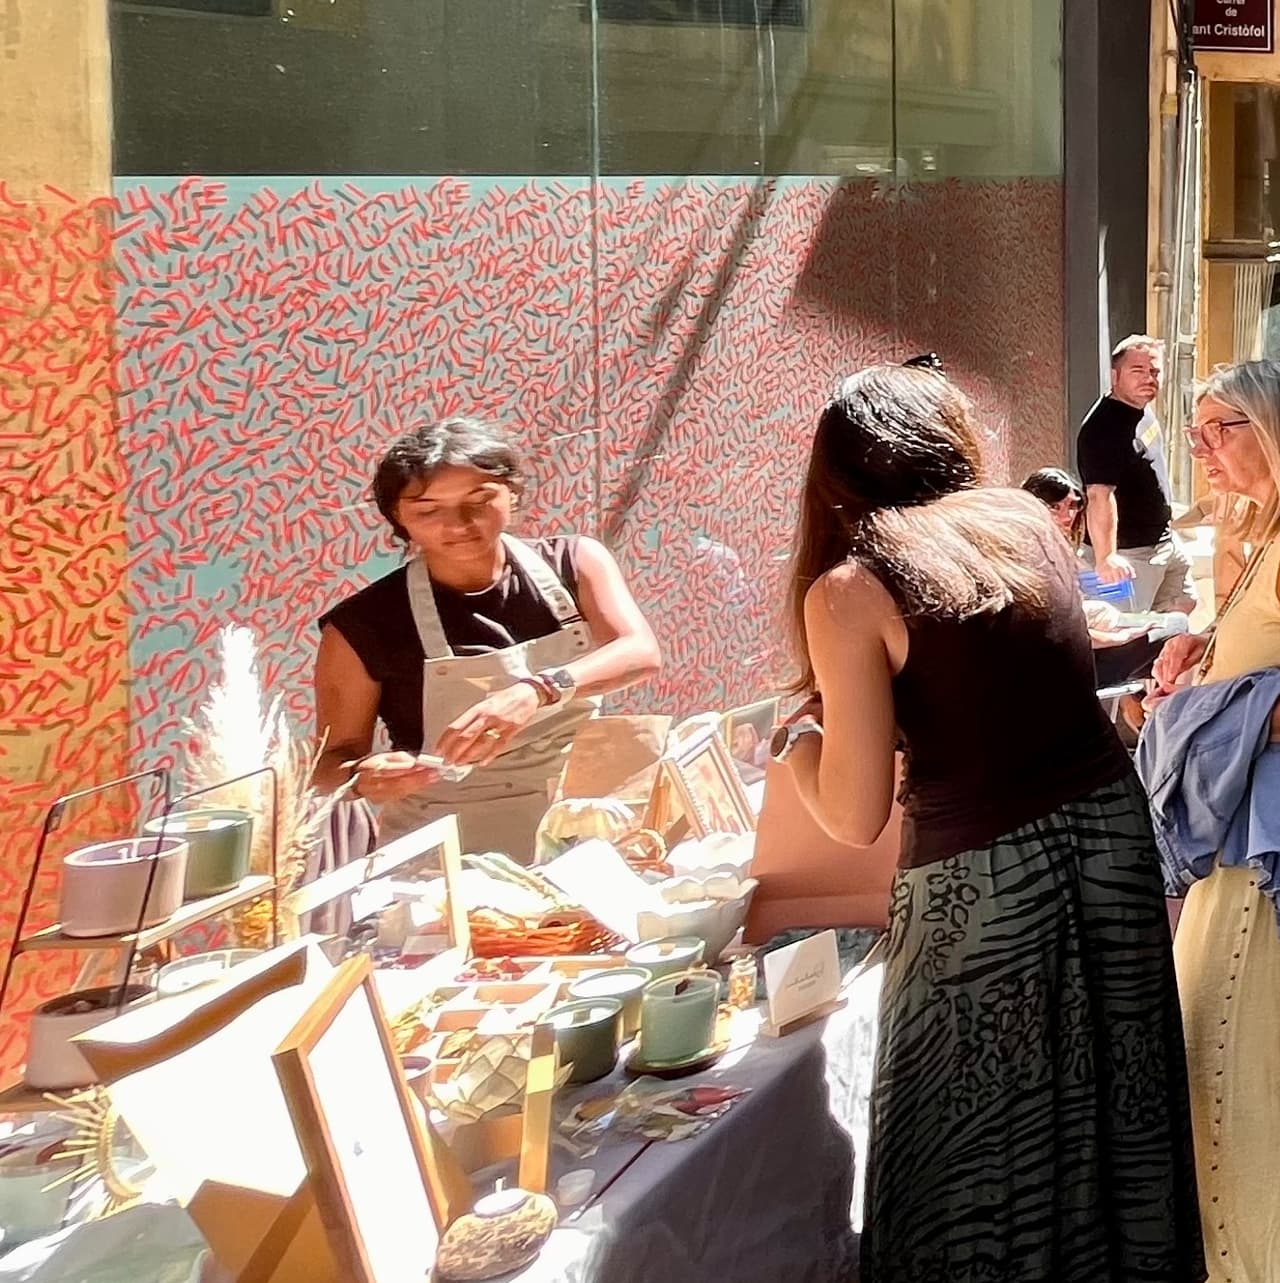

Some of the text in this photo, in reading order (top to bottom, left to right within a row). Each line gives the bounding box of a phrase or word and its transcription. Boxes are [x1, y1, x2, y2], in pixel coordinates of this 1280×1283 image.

[1225, 7, 1238, 17] de
[1192, 23, 1265, 37] ant Cristòfol
